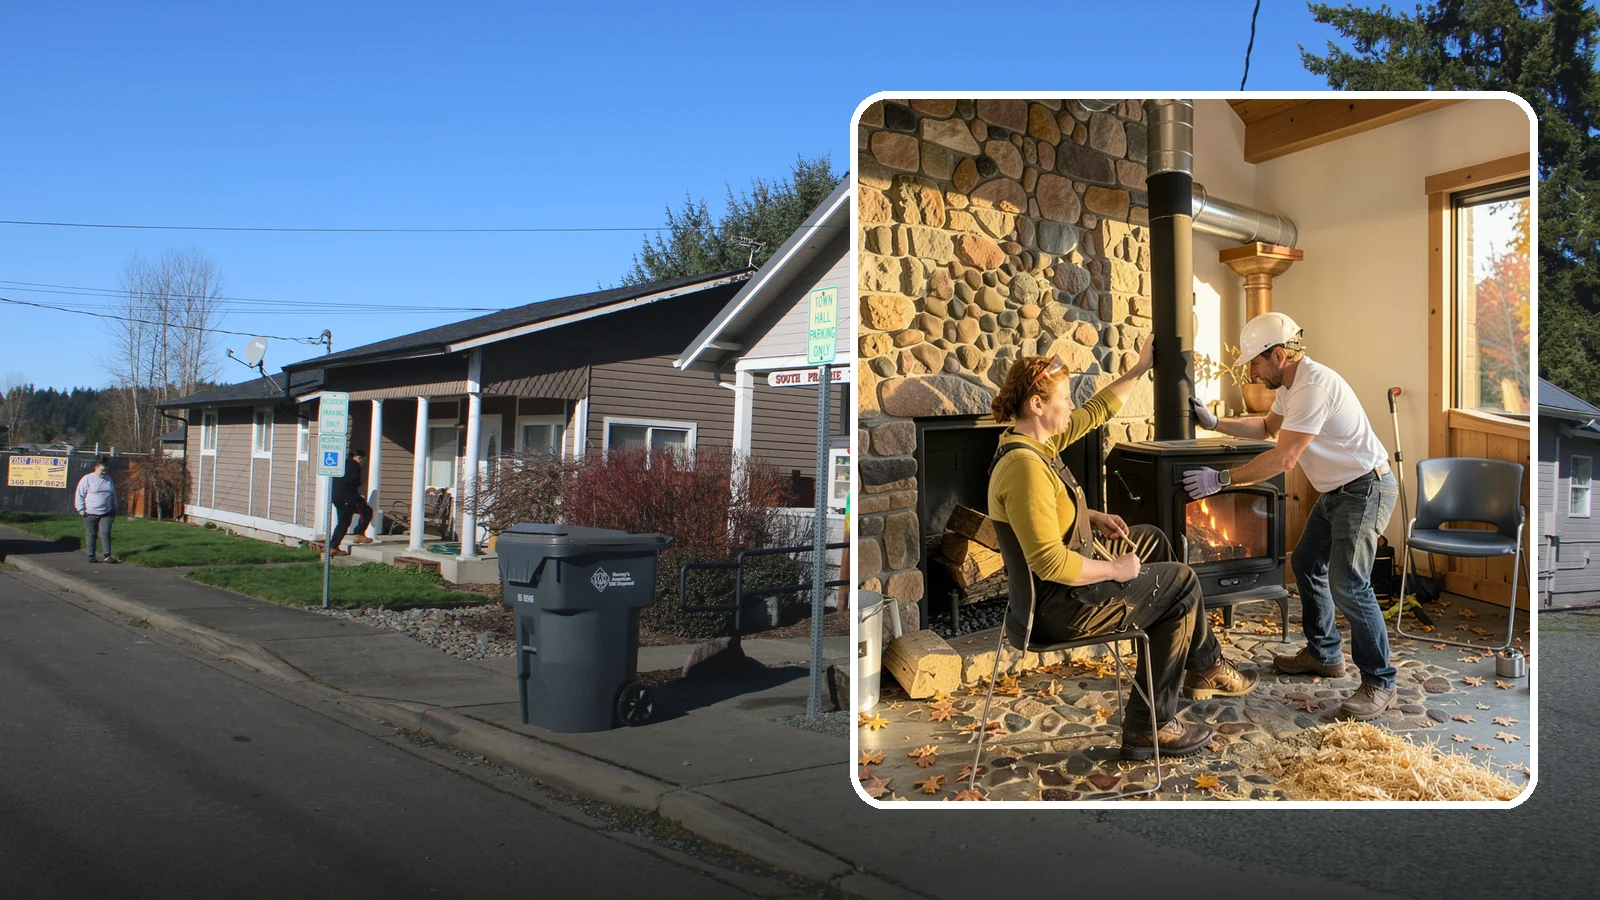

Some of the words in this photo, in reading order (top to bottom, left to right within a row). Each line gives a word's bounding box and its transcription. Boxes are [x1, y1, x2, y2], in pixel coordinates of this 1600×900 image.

[815, 295, 833, 307] TOWN
[814, 311, 831, 324] HALL
[810, 327, 836, 340] PARKING
[814, 344, 831, 357] ONLY
[776, 373, 800, 384] SOUTH
[808, 371, 841, 382] PRIE
